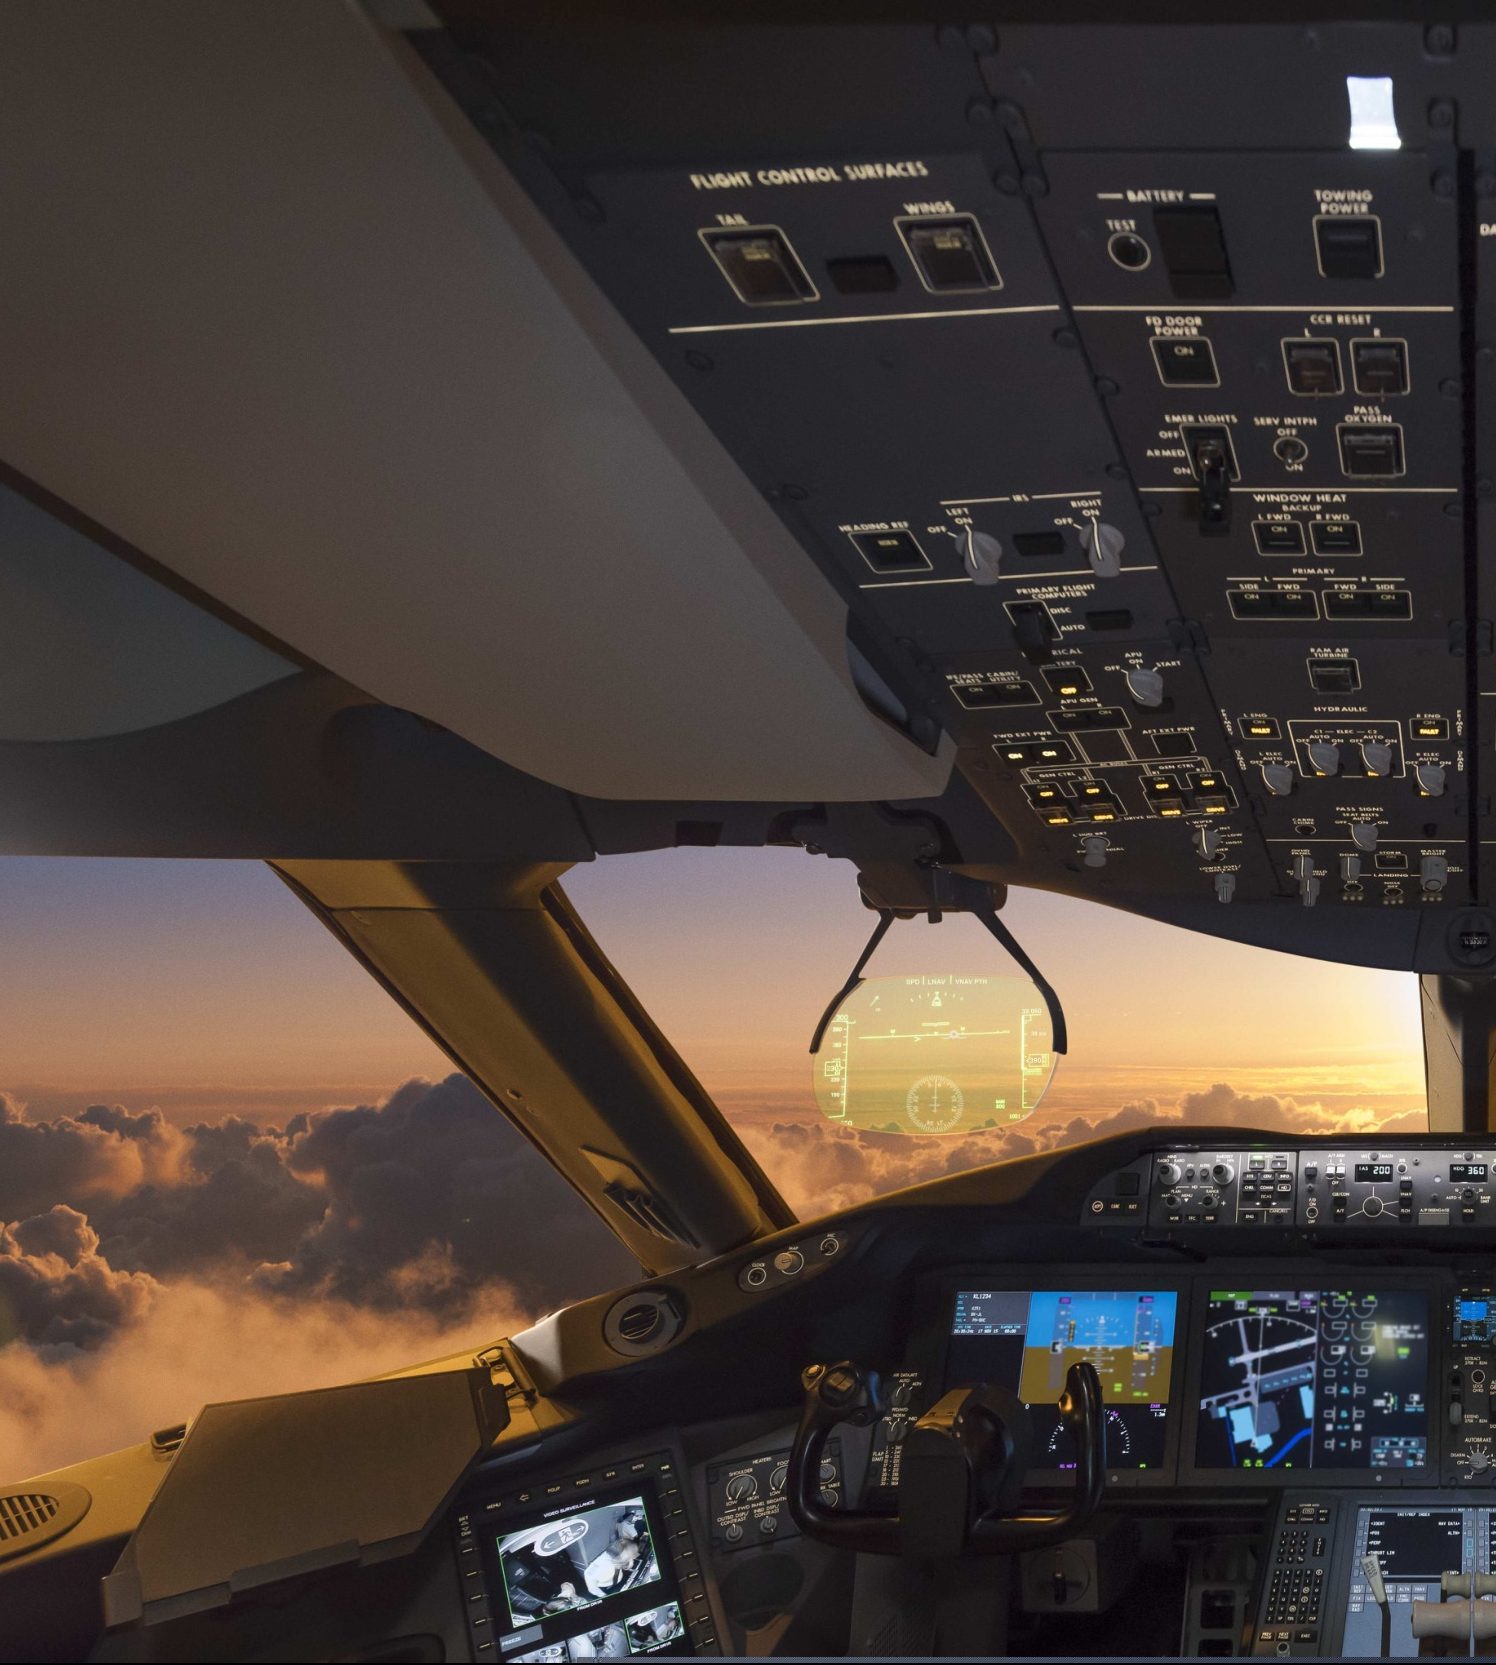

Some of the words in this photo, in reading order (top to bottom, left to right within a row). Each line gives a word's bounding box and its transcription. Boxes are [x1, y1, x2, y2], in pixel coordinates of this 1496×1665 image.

[690, 171, 752, 190] FLIGHT
[757, 166, 841, 184] CONTROL
[844, 161, 928, 181] SURFACES
[1126, 190, 1184, 202] BATTERY
[1314, 190, 1373, 202] TOWING
[902, 201, 956, 214] WINGS
[1320, 203, 1369, 214] POWER
[715, 214, 748, 226] TAIL
[1106, 220, 1136, 231] TEST
[1165, 316, 1202, 327] DOOR
[1310, 315, 1334, 325] CCR
[1337, 315, 1372, 325] RESET
[1155, 326, 1198, 337] POWER
[1174, 346, 1193, 356] ON
[1354, 406, 1380, 415] PASS
[1164, 414, 1195, 424] EMER
[1199, 414, 1238, 424] LIGHTS
[1254, 417, 1280, 426] SERV
[1284, 417, 1317, 426] INTPH
[1345, 414, 1392, 423] OXYGEN
[1159, 431, 1179, 440] OFF
[1277, 428, 1297, 437] OFF
[1146, 449, 1185, 458] ARMED
[1173, 467, 1191, 476] ON
[1253, 494, 1311, 503] WINDOW
[1316, 494, 1347, 503] HEAT
[1070, 499, 1102, 508] RIGHT
[946, 507, 969, 516] LEFT
[1082, 508, 1100, 517] ON
[1282, 504, 1322, 513] BACKUP
[955, 516, 973, 525] ON
[1054, 517, 1073, 526] OFF
[1266, 513, 1291, 521] FWD
[1325, 513, 1350, 521] FWD
[839, 523, 887, 532] HEADING
[927, 526, 947, 534] OFF
[1292, 568, 1335, 576] PRIMARY
[1016, 586, 1061, 596] PRIMARY
[1063, 583, 1096, 592] FLIGHT
[1031, 591, 1087, 600] COMPUTERS
[1050, 606, 1072, 615] DISC
[1060, 623, 1086, 632] AUTO
[1061, 687, 1077, 695] OFF
[1373, 1166, 1391, 1175] 200
[1467, 1166, 1485, 1175] 360
